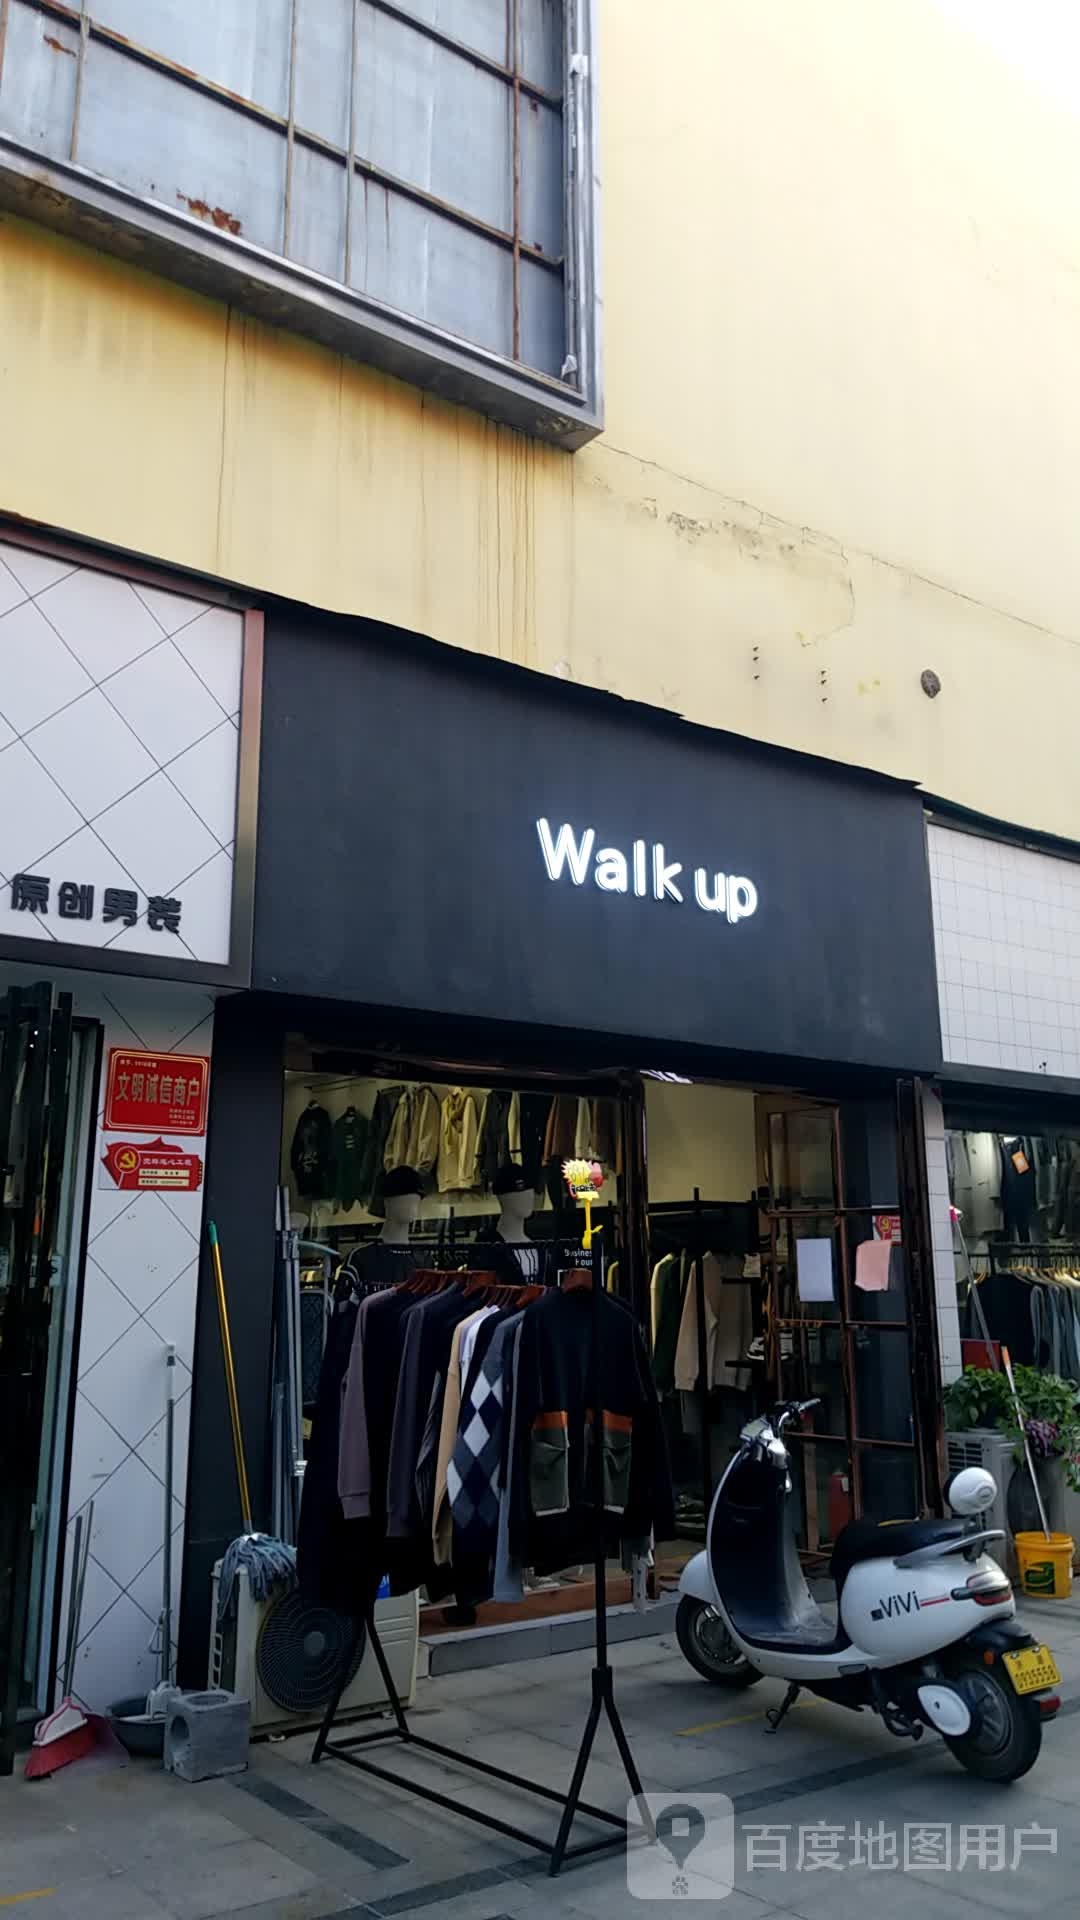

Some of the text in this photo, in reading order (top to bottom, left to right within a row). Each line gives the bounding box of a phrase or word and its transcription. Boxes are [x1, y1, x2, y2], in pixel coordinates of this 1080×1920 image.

[536, 817, 758, 924] Walk up
[11, 873, 182, 934] 原创男装
[115, 1072, 200, 1106] 文明诚信商户
